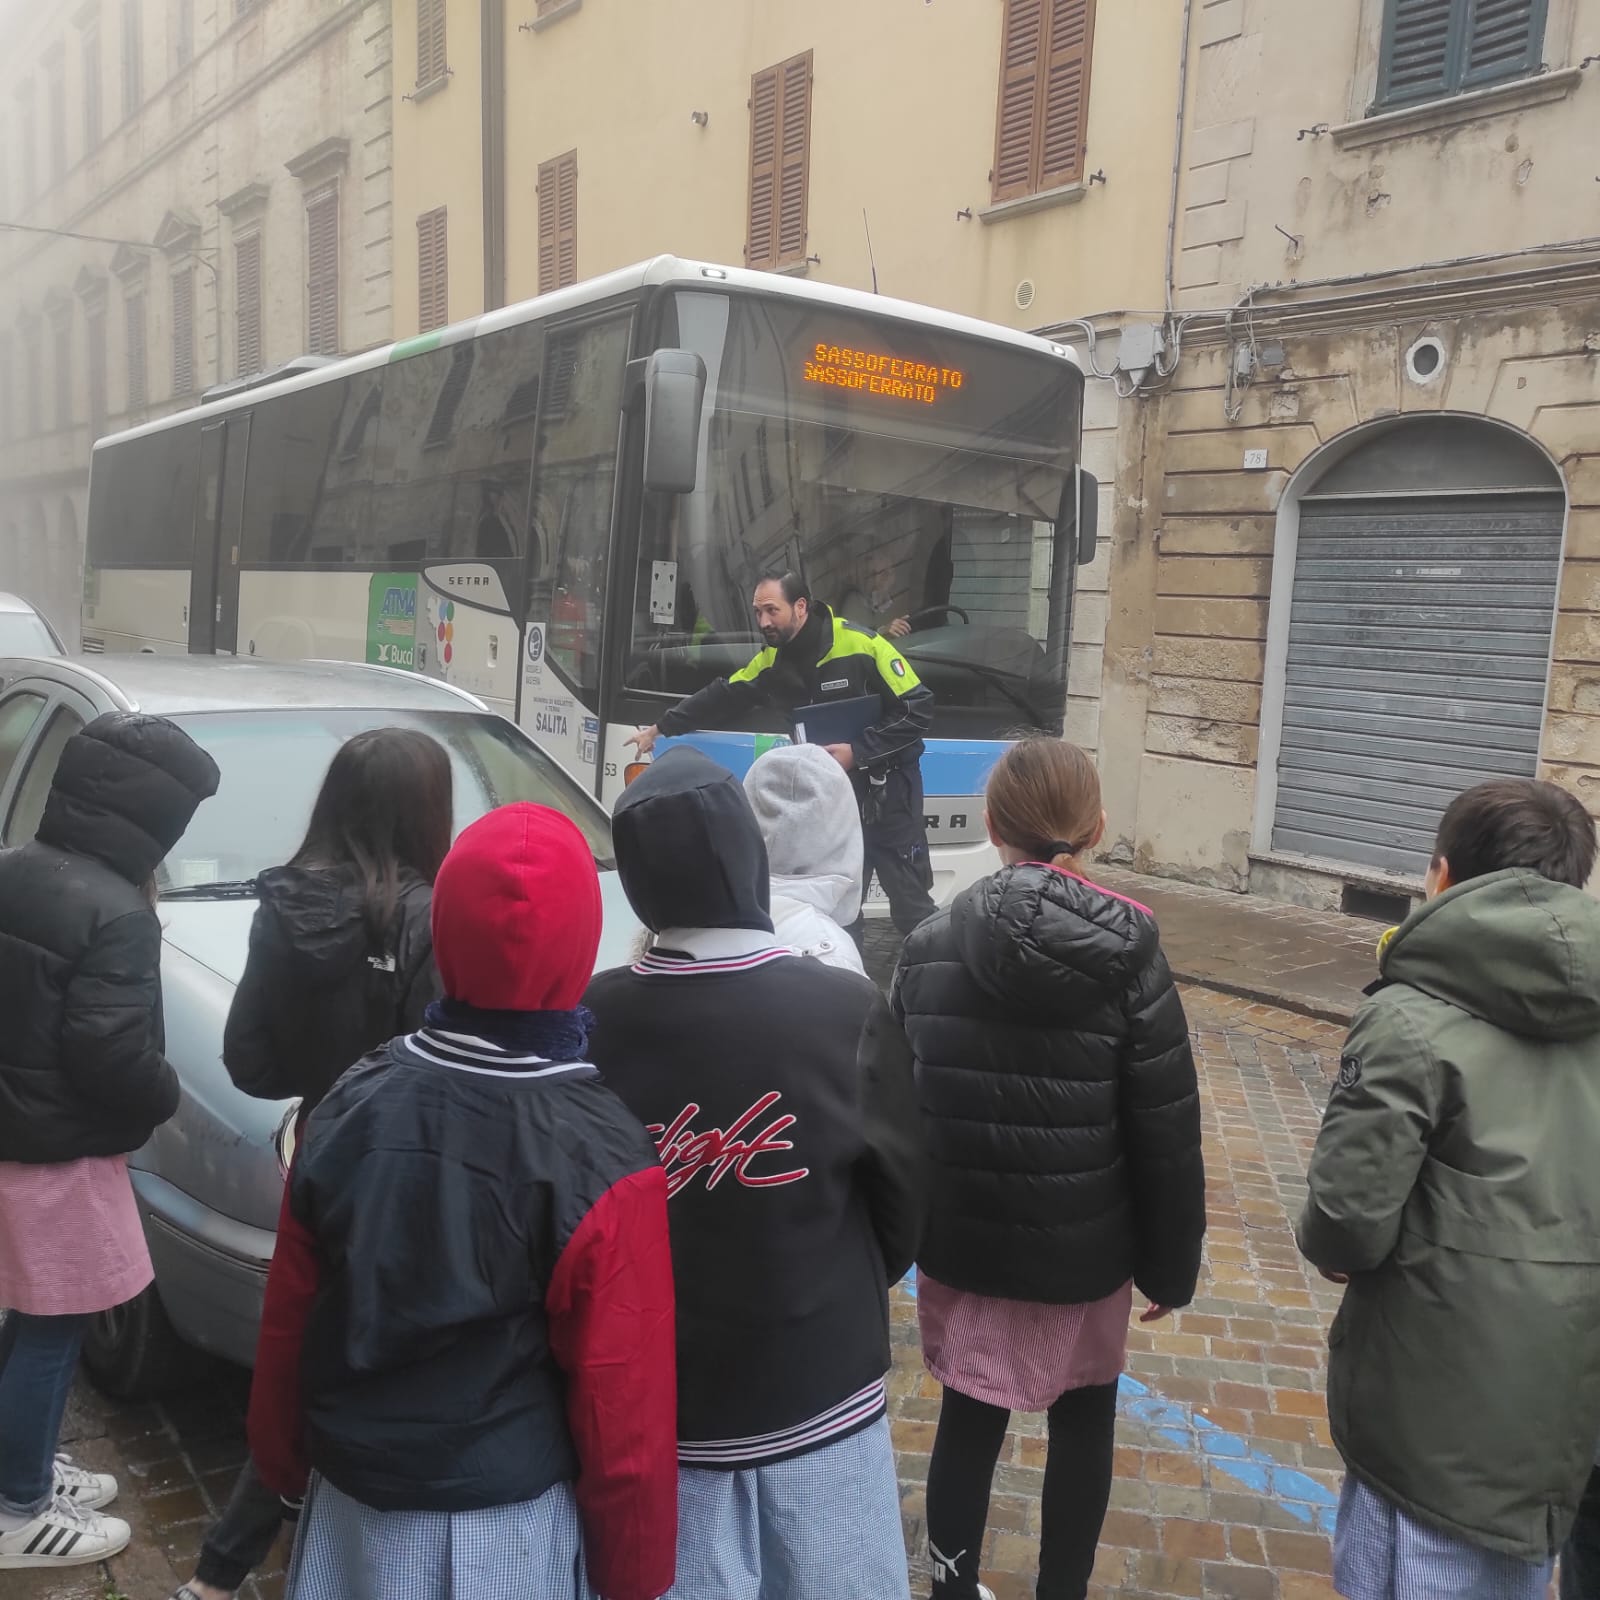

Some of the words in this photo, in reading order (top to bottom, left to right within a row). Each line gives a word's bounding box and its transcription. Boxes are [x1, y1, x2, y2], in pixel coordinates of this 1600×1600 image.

[815, 343, 963, 388] SASSOFERRATO
[448, 576, 490, 585] SETRA
[391, 643, 414, 665] Bucci
[535, 711, 568, 736] SALITA
[604, 762, 617, 777] 53
[645, 1091, 810, 1200] light
